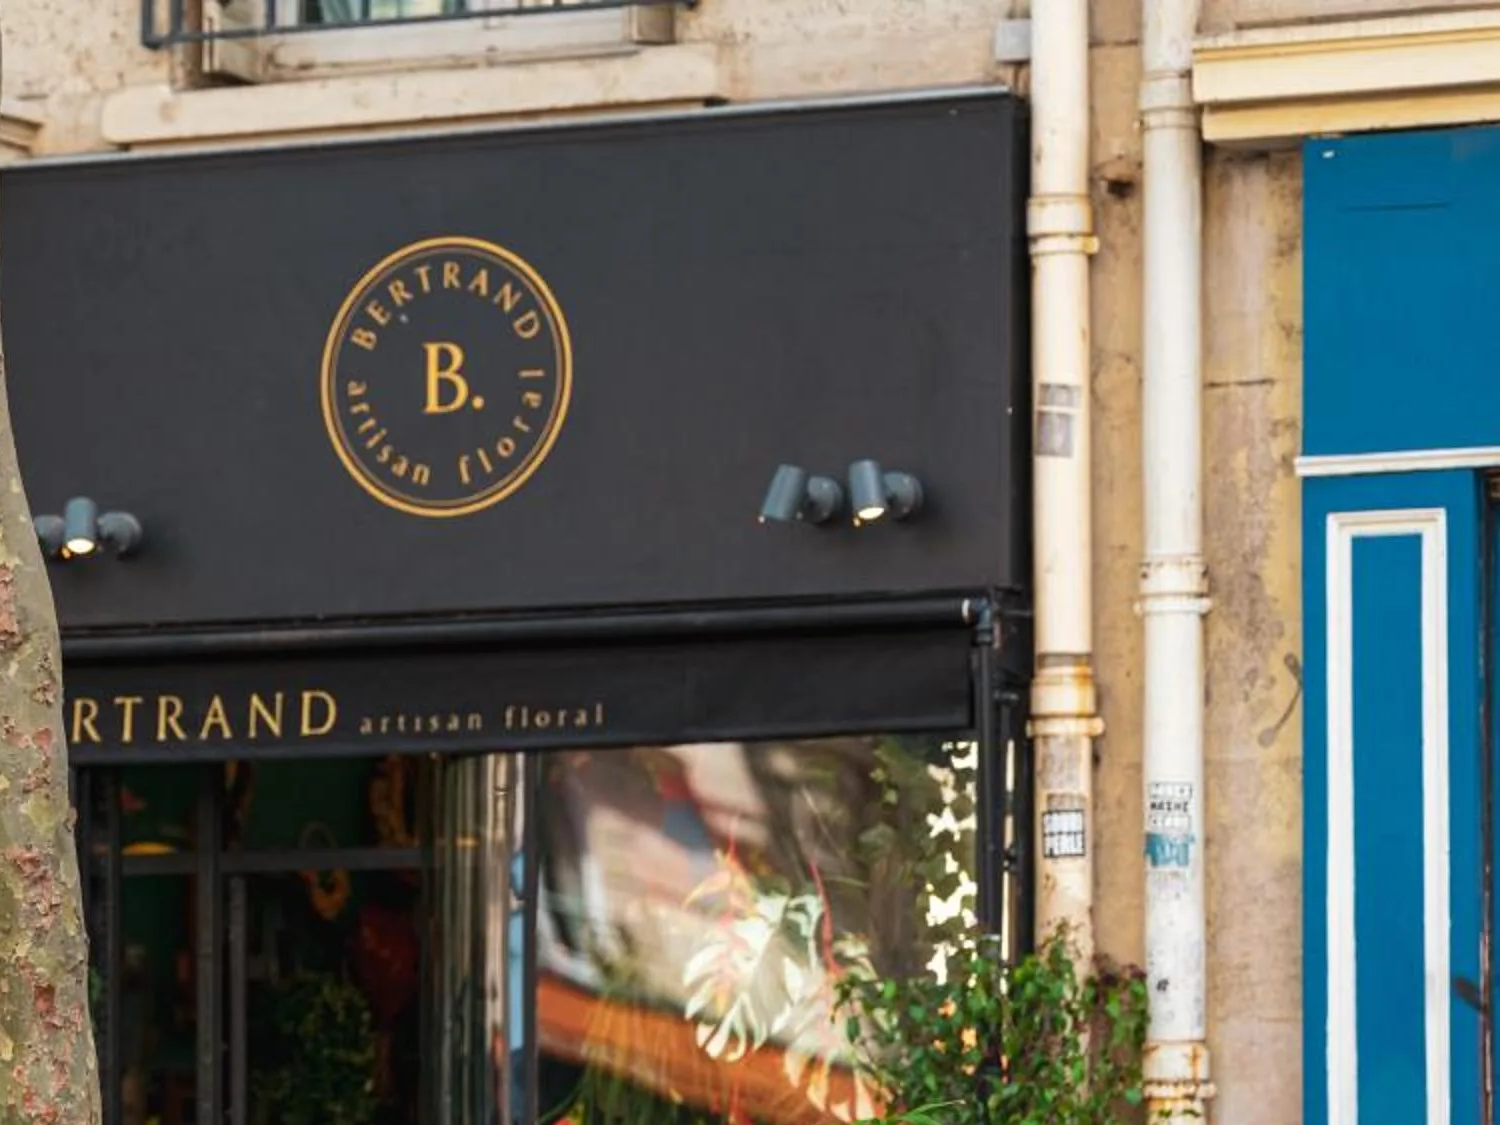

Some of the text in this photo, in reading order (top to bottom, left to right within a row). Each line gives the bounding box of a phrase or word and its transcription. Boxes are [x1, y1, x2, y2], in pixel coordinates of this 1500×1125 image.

[350, 261, 541, 350] BERTRAND
[422, 341, 485, 415] B.
[347, 368, 545, 486] artisan floral
[71, 689, 604, 744] RTRAND artisan floral
